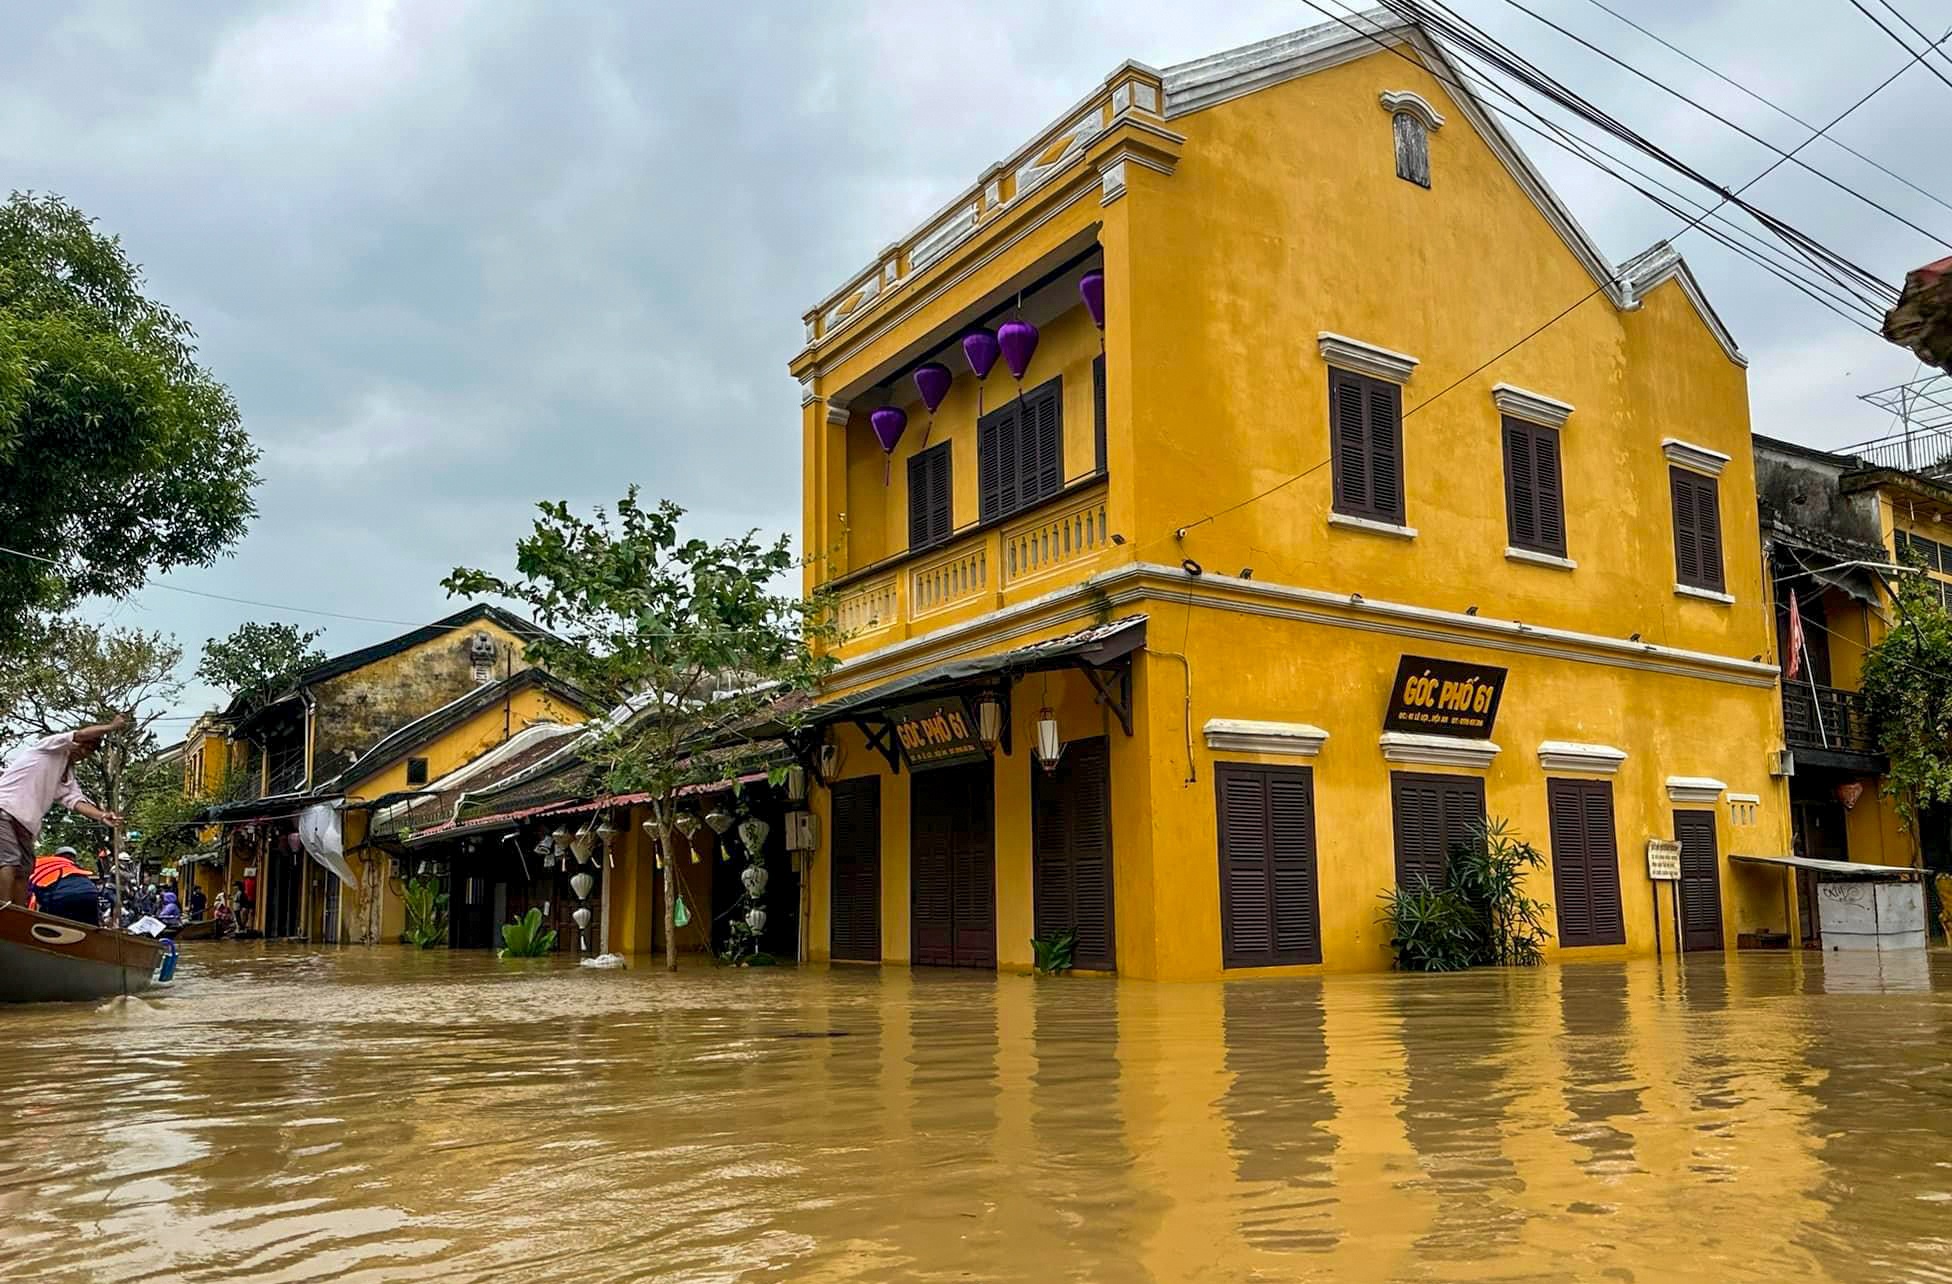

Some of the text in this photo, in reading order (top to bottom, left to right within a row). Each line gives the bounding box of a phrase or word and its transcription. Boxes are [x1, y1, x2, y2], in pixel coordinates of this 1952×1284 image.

[1403, 669, 1494, 713] GÓC PHỐ 61
[896, 707, 969, 750] GÓC PHỐ 61
